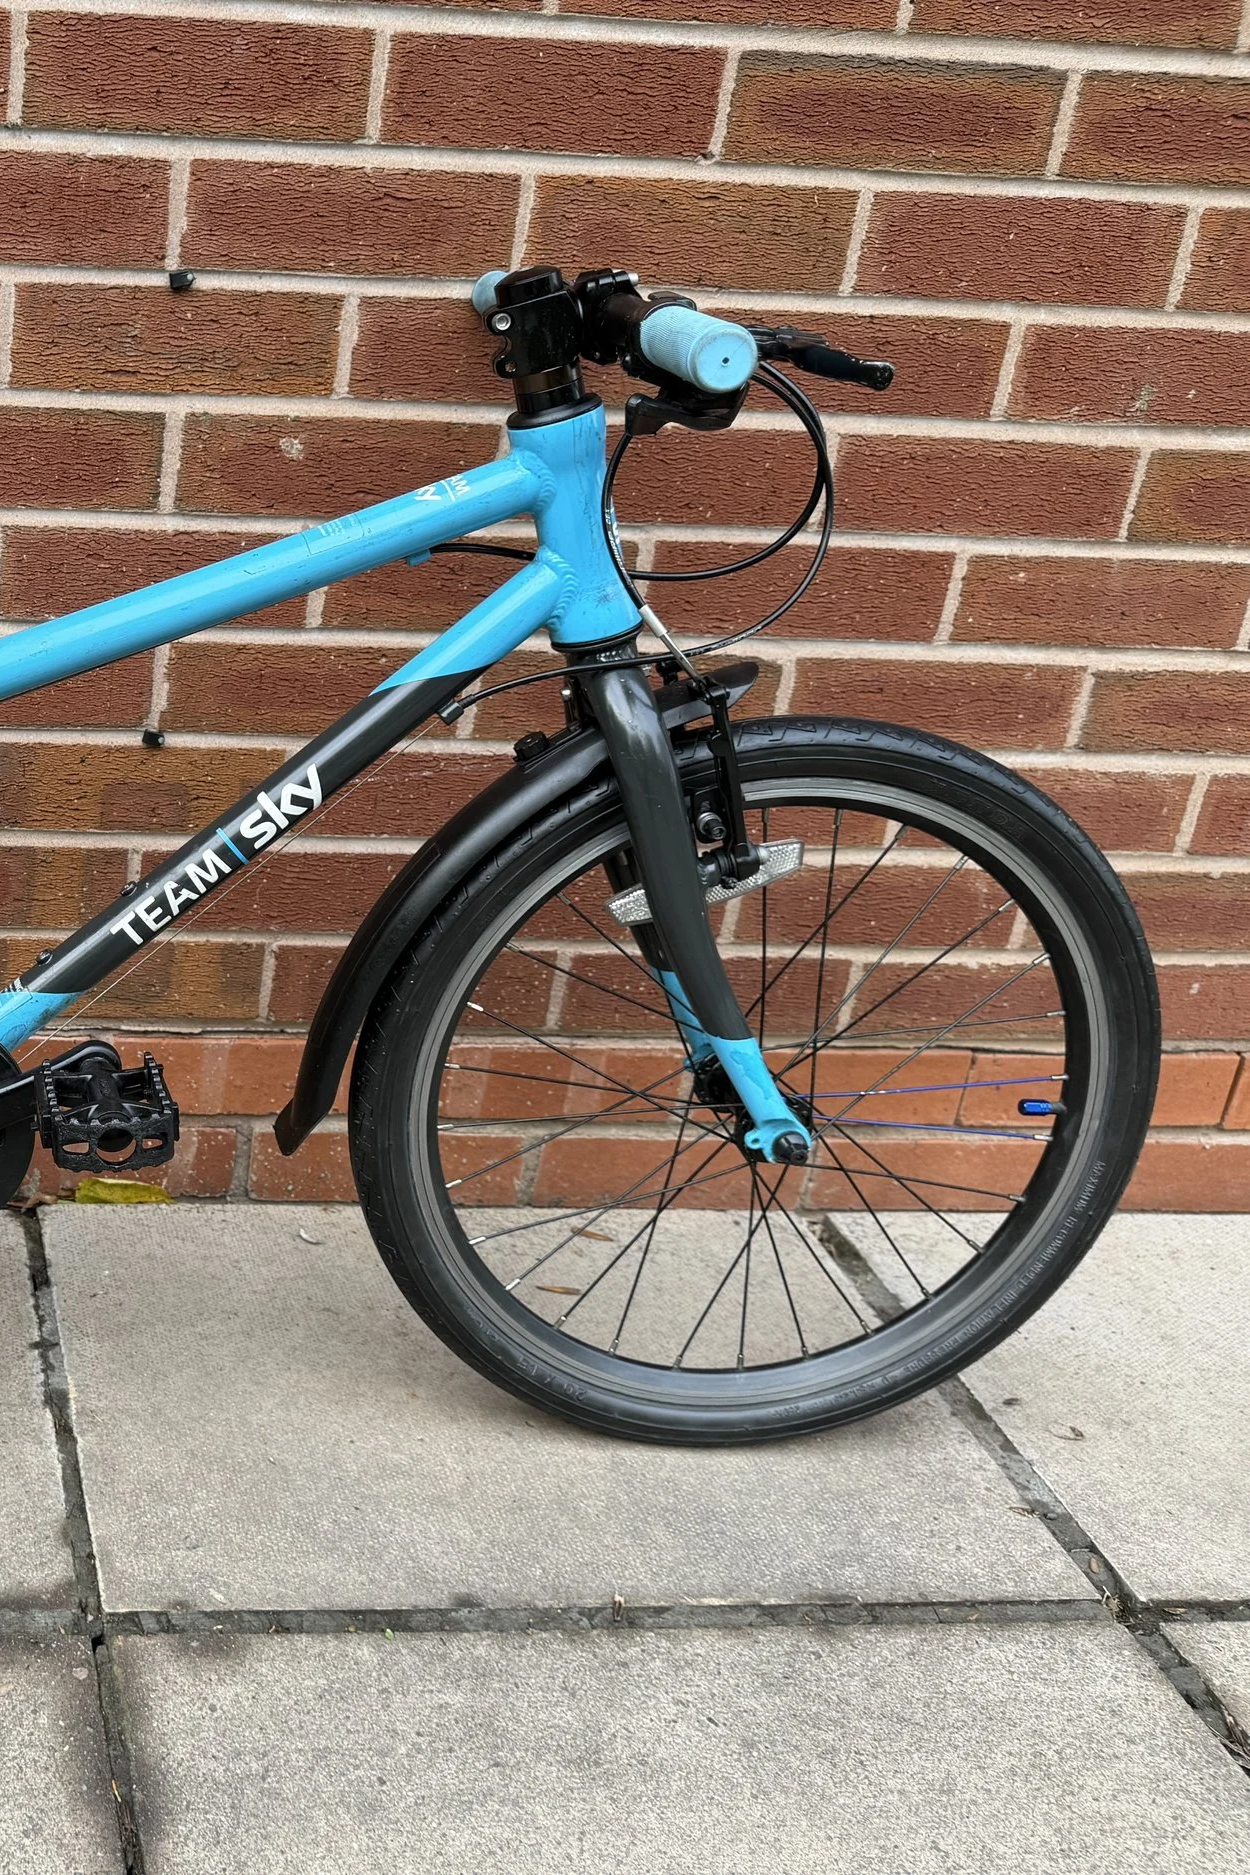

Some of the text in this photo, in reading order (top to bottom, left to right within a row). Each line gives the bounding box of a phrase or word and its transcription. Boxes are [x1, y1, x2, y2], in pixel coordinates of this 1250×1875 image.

[109, 763, 323, 946] TEAM sky
[1075, 1160, 1106, 1216] MAXIMUM
[1016, 1215, 1078, 1290] RECOMMENDED
[963, 1290, 1020, 1339] INFLATION
[902, 1336, 962, 1376] PRESSURE
